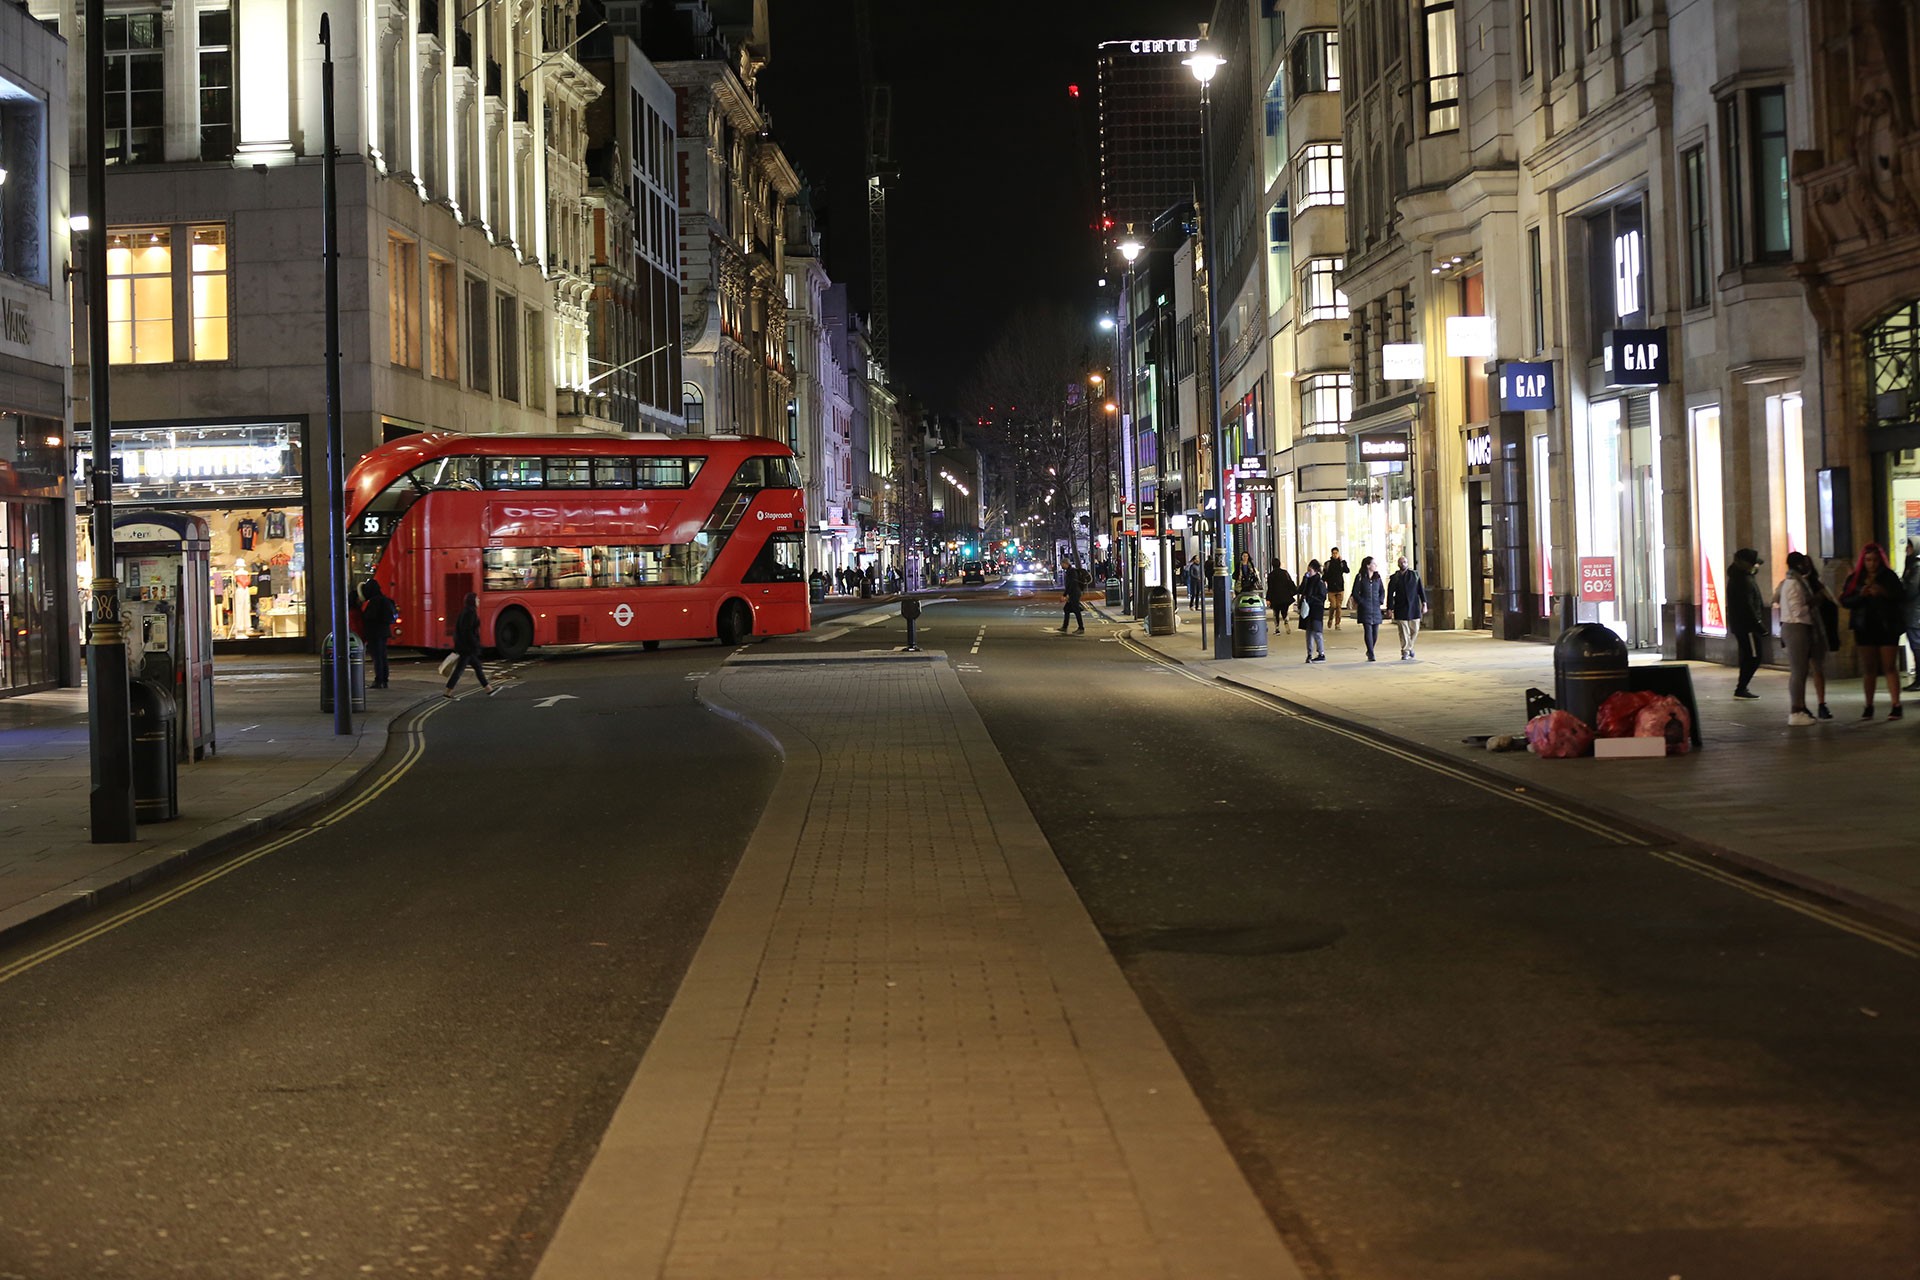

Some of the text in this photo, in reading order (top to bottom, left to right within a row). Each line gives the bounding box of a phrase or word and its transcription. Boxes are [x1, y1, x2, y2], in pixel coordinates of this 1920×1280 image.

[1130, 41, 1198, 53] CENTRE
[1624, 344, 1659, 371] GAP
[1516, 375, 1546, 398] GAP
[1467, 434, 1491, 466] MANG
[764, 512, 793, 521] Stagecoach
[363, 517, 380, 533] 55
[1583, 569, 1611, 577] SALE
